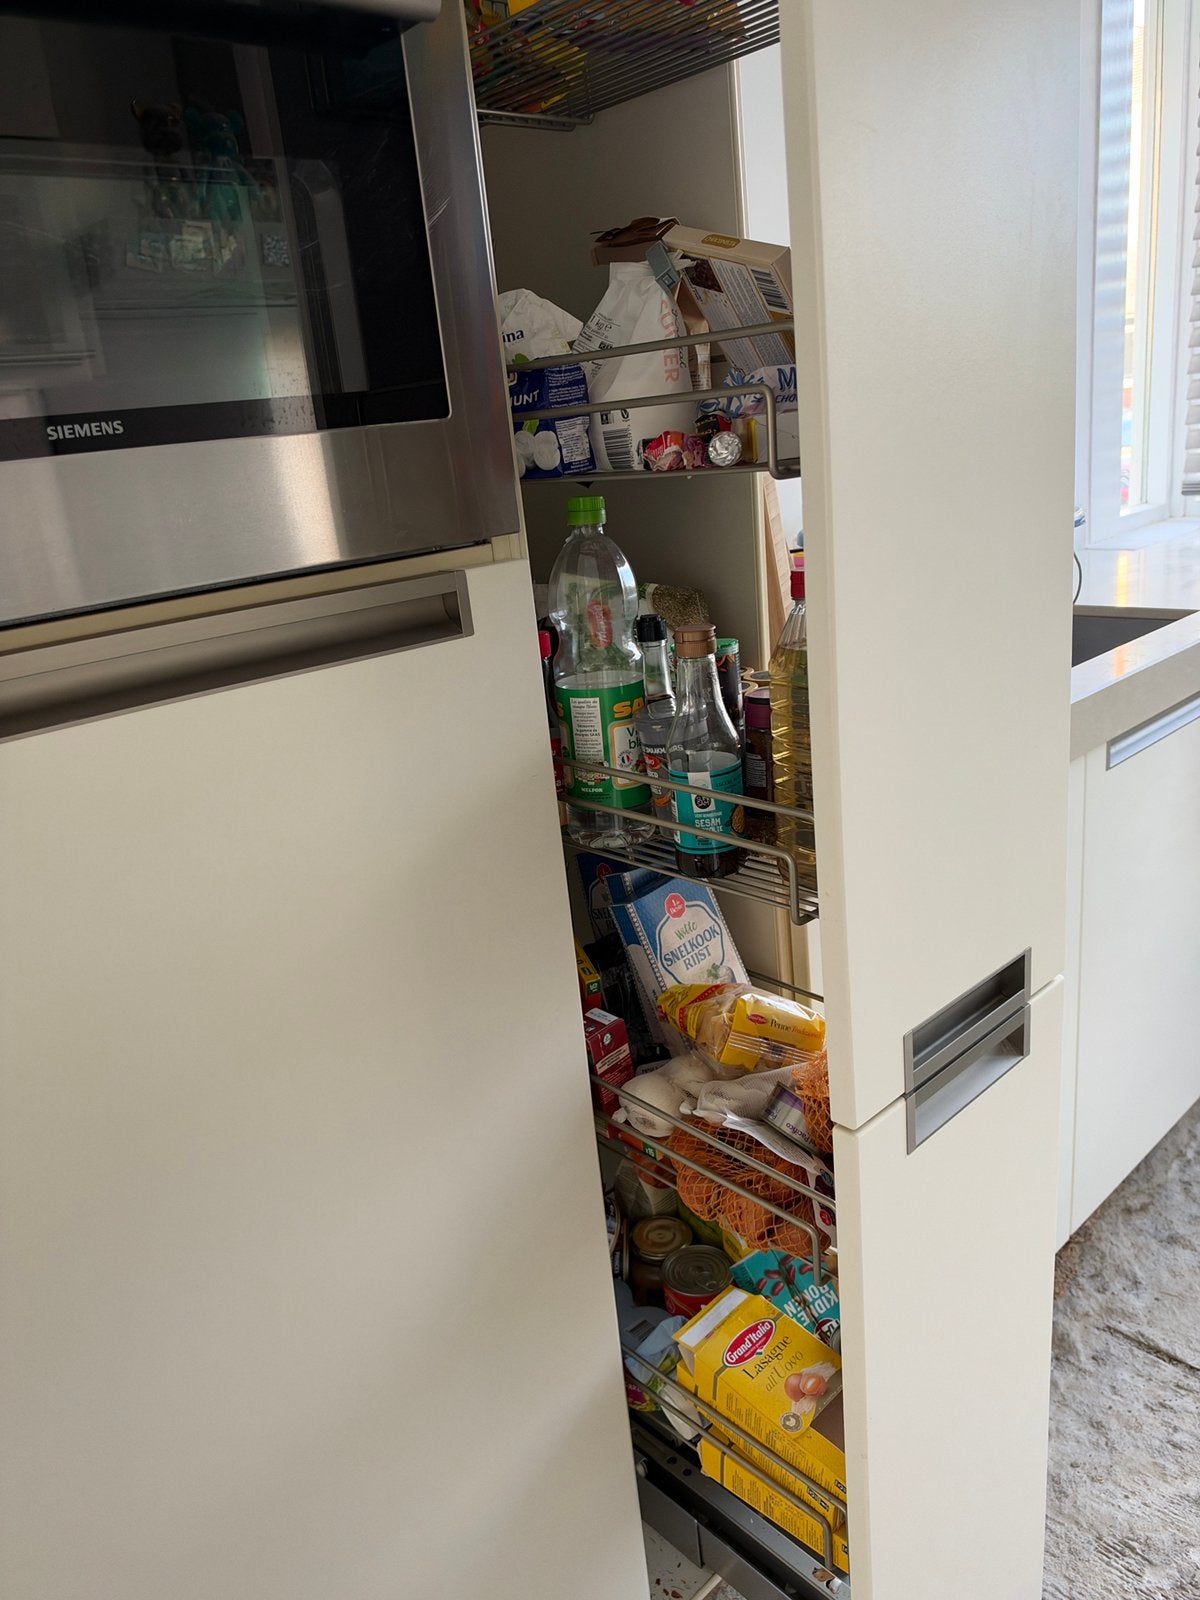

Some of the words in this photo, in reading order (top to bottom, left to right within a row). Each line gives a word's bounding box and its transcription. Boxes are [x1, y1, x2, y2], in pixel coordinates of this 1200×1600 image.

[502, 329, 525, 343] ina
[595, 320, 605, 331] kg
[511, 389, 539, 406] UNT
[46, 420, 124, 441] SIEMENS
[695, 818, 721, 828] SESAM
[674, 920, 698, 941] Witte
[663, 925, 720, 967] SNELKOOK
[683, 944, 712, 971] RIJST
[771, 1018, 791, 1032] Penne
[796, 1290, 839, 1327] KIDE
[726, 1321, 771, 1363] Grand'Italia
[742, 1336, 792, 1380] Lasagne
[765, 1351, 804, 1392] all'Uovo
